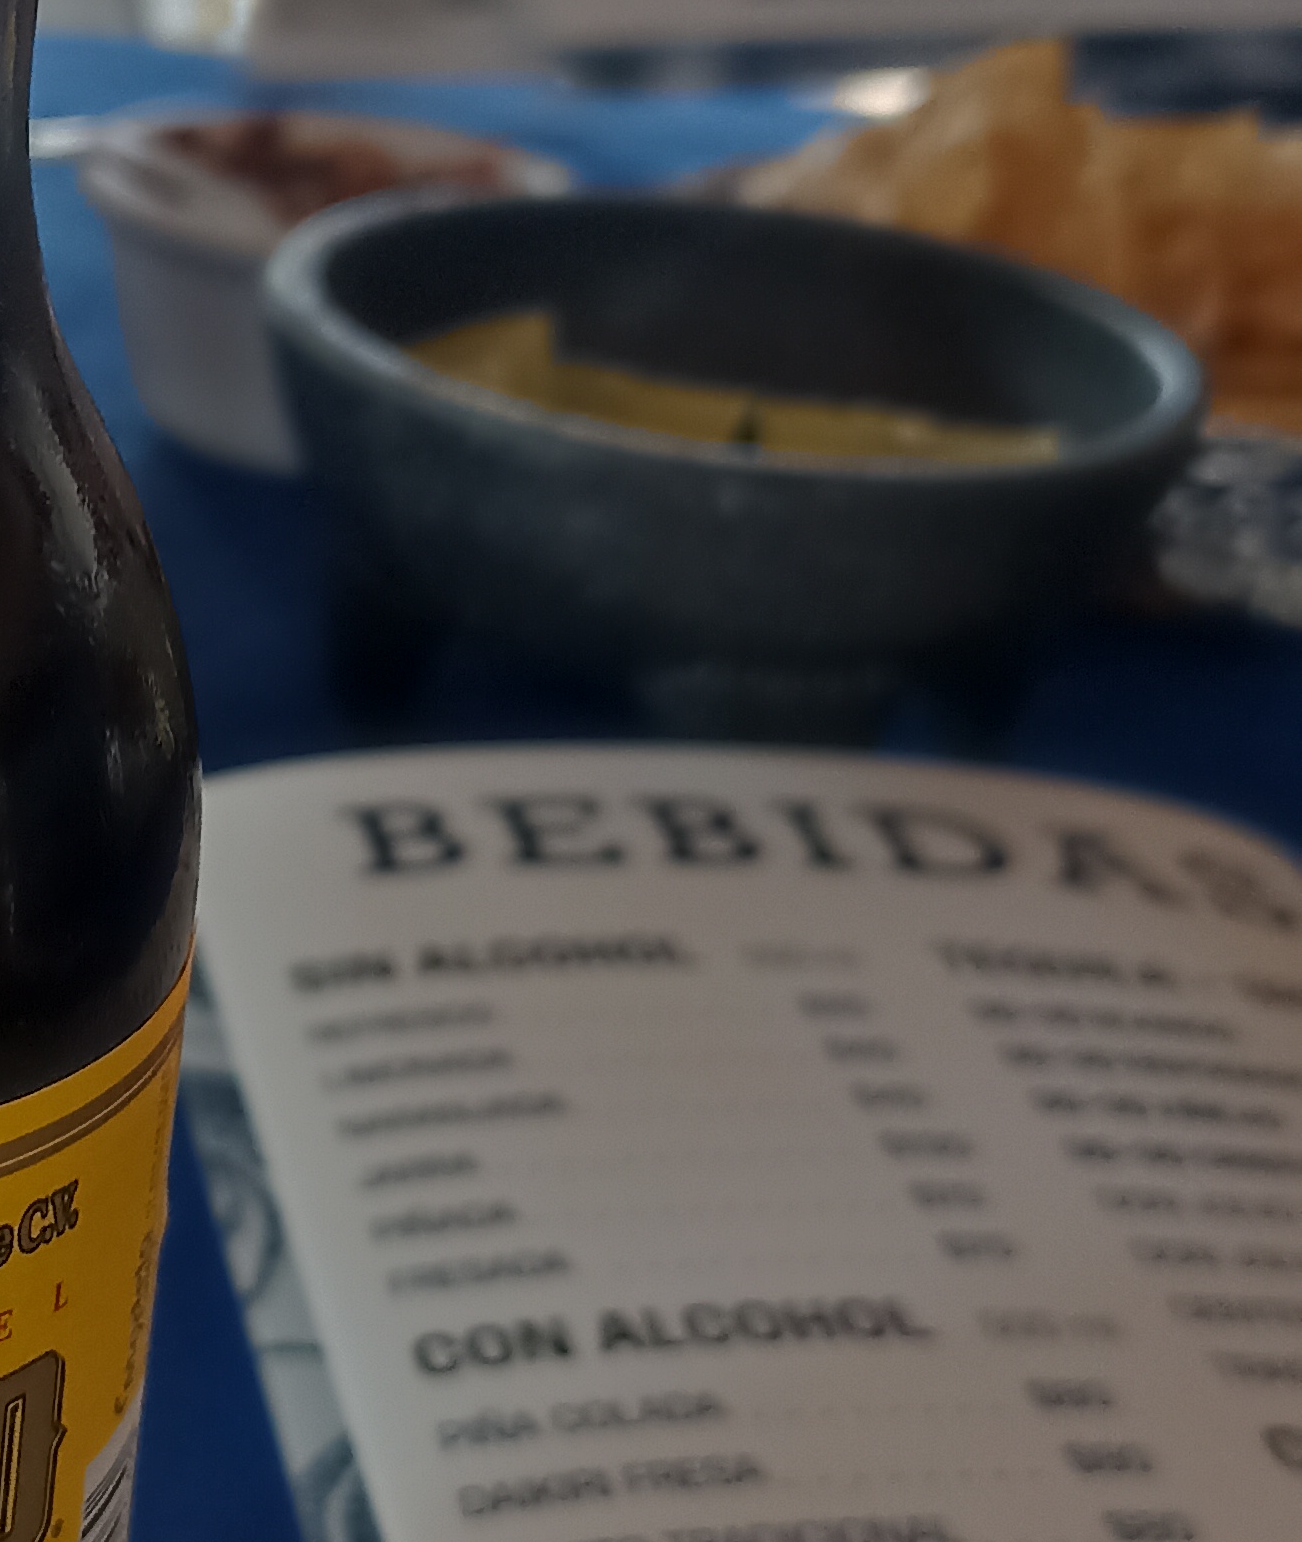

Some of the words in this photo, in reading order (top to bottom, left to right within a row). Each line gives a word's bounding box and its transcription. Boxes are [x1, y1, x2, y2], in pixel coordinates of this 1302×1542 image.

[346, 794, 1298, 931] BEBIDAS
[414, 1314, 574, 1374] CON
[601, 1294, 936, 1351] ALCOHOL
